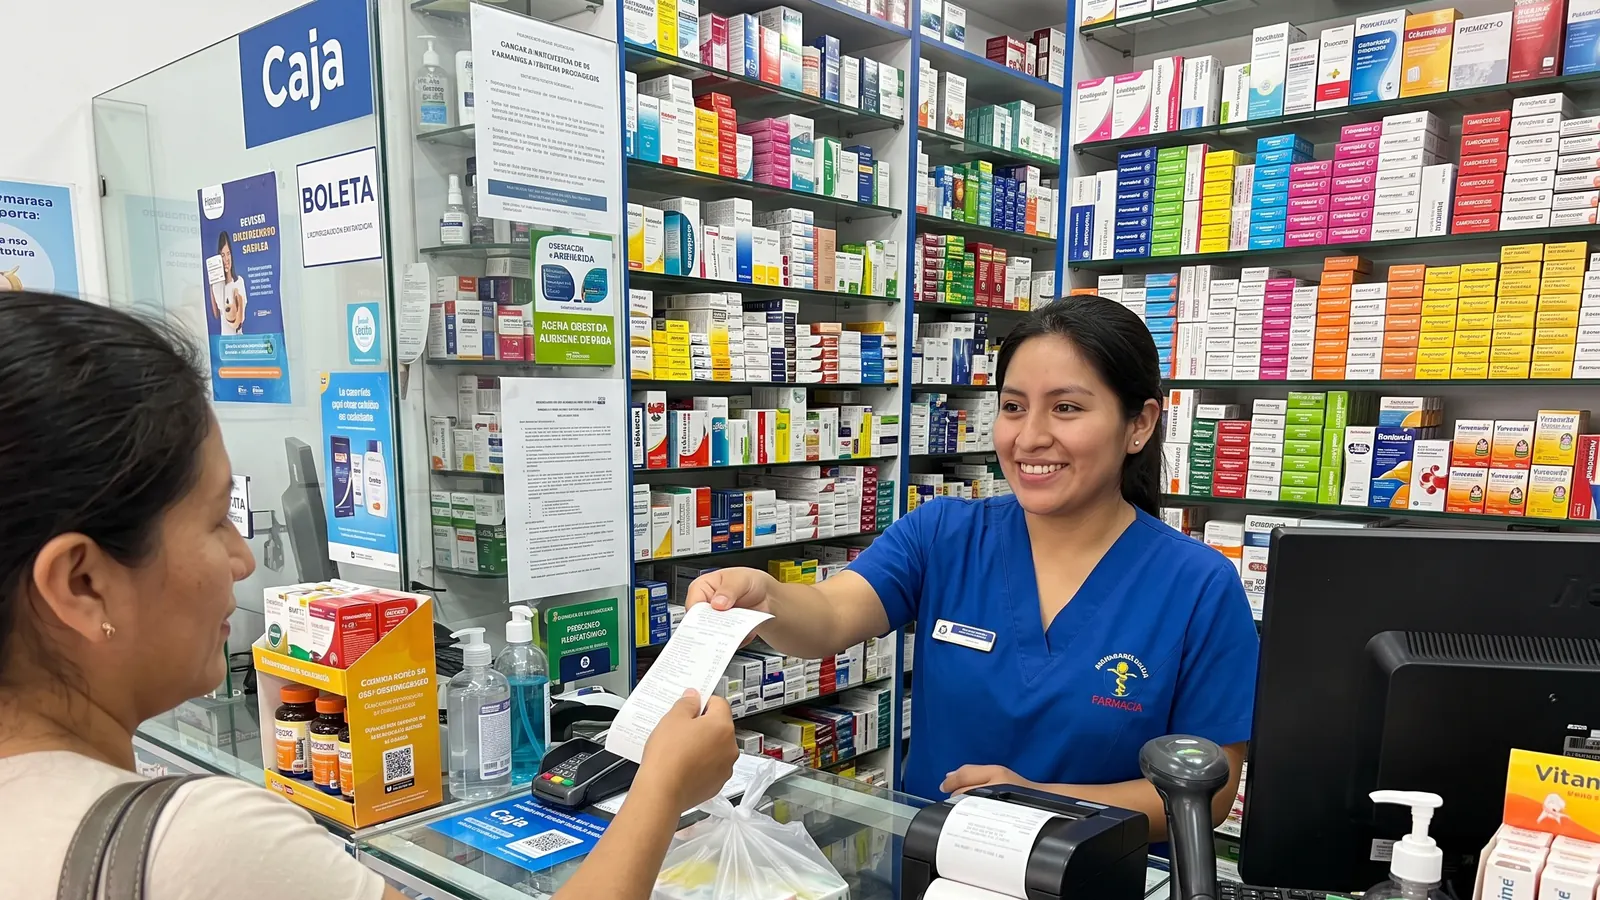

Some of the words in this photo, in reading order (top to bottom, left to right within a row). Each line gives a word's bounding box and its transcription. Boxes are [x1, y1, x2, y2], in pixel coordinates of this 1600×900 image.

[262, 27, 345, 112] Caja
[302, 174, 375, 214] BOLETA
[1091, 694, 1143, 713] FARMACIA
[490, 808, 529, 829] Caja
